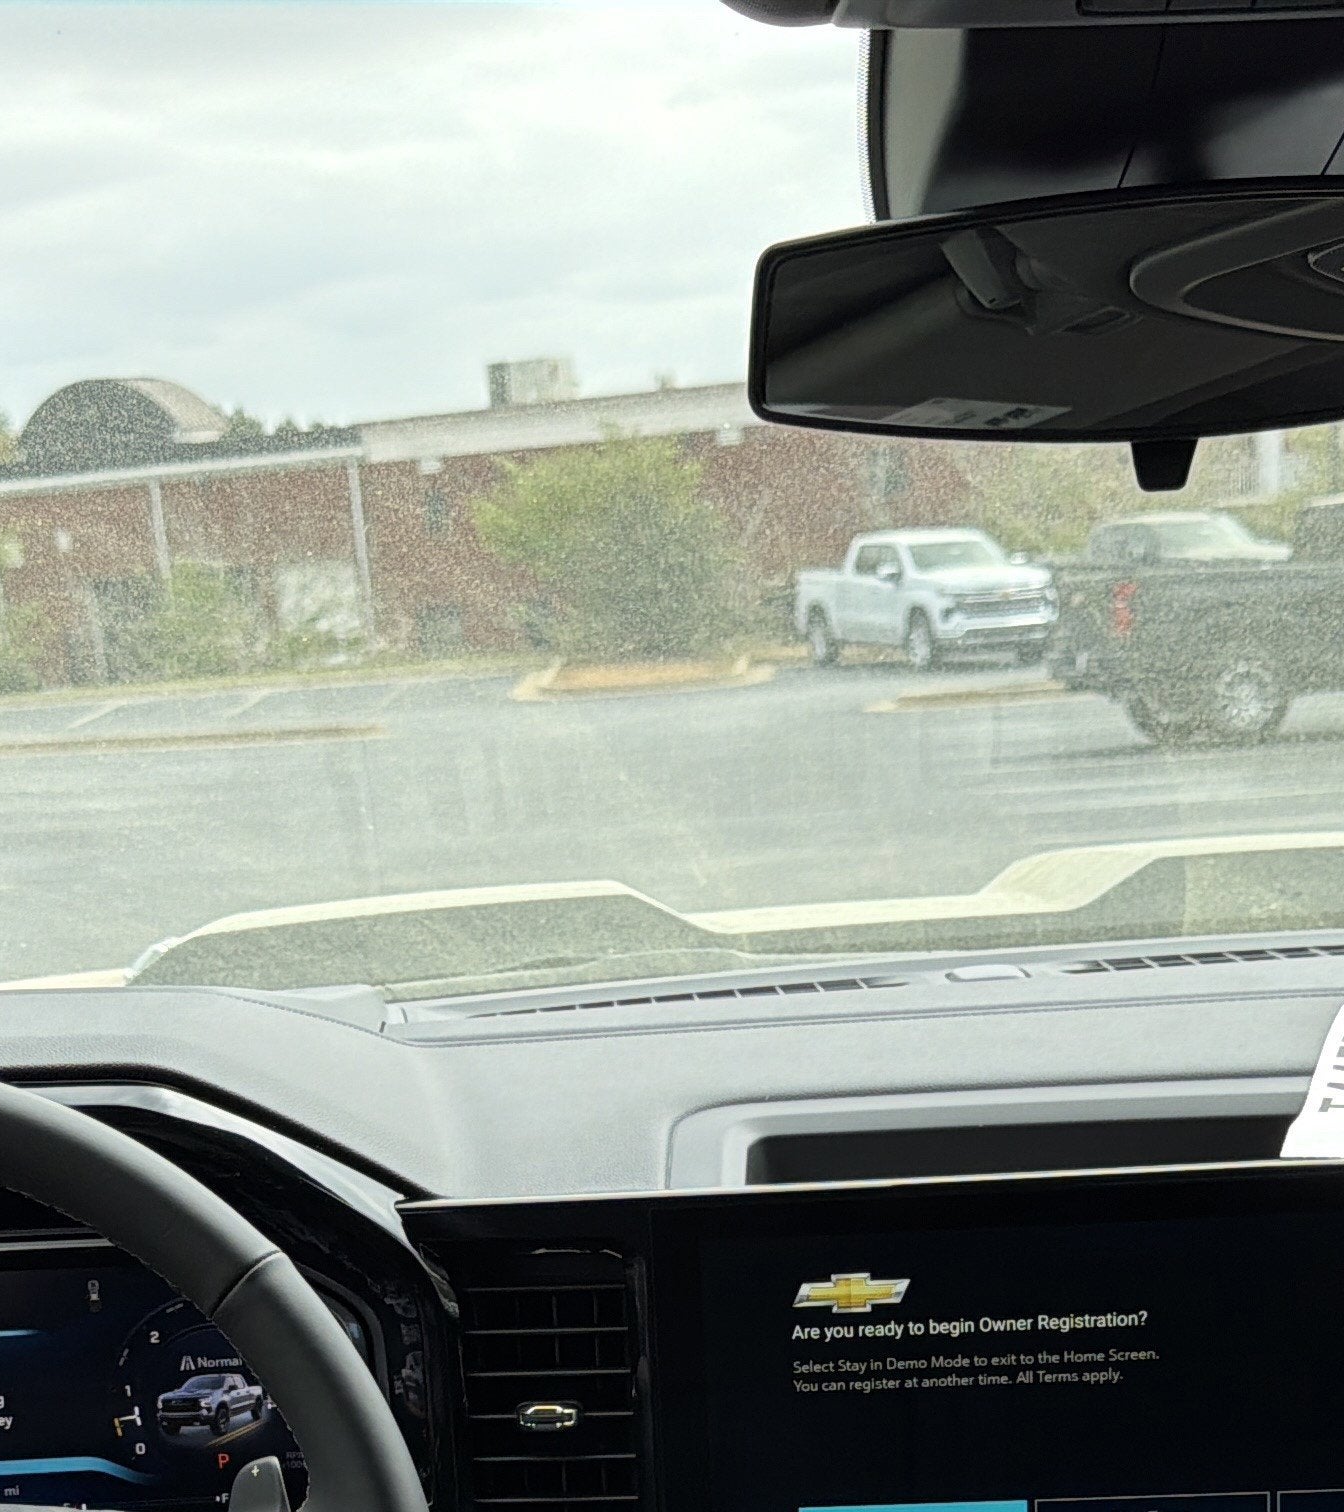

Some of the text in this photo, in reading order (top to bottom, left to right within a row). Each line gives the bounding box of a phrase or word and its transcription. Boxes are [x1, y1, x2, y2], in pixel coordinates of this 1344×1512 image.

[792, 1310, 1148, 1342] Are you ready to begin Owner Registration?
[150, 1331, 160, 1343] 2
[793, 1349, 1160, 1374] Select Stay in Demo Mode to exit to the Home Screen.
[793, 1367, 1123, 1393] You can register at another time. All Terms apply.
[135, 1443, 146, 1455] 0
[218, 1453, 230, 1469] P
[4, 1485, 20, 1496] mi
